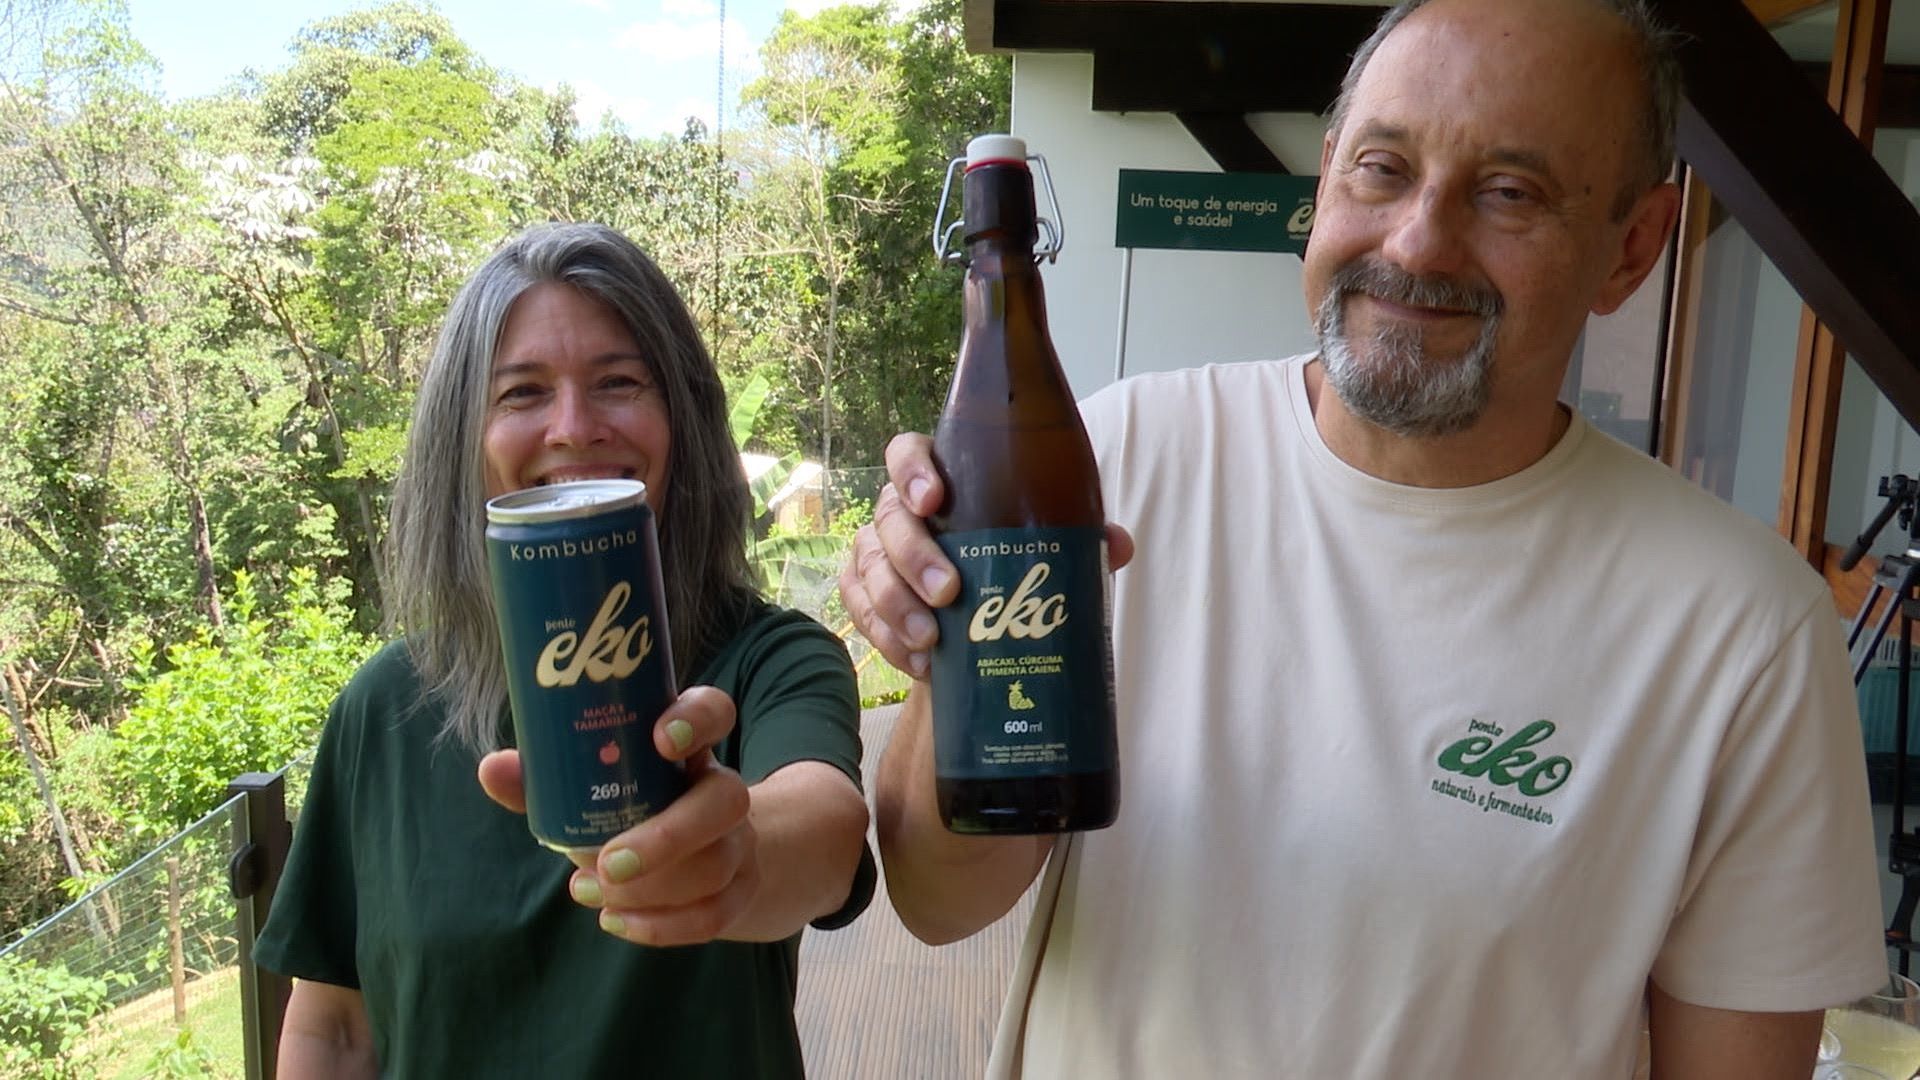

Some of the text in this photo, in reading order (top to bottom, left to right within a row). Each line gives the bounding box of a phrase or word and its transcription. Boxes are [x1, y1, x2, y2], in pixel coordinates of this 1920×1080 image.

[1130, 193, 1278, 216] Um toque de energia
[1173, 213, 1233, 228] e saúde!
[510, 530, 637, 561] Kombucha
[959, 540, 1061, 559] Kombucha
[969, 562, 1069, 642] eko
[536, 580, 653, 688] eko
[977, 655, 1063, 668] ABACAXI, CÚRCUMA
[980, 664, 1061, 677] E PIMENTA CAIENA
[574, 713, 637, 732] TAMARILLO
[1004, 720, 1043, 734] 600 ml
[1468, 718, 1504, 737] ponto
[1437, 719, 1573, 797] eko
[591, 779, 639, 800] 269 ml
[1431, 777, 1554, 826] naturais e fermentados
